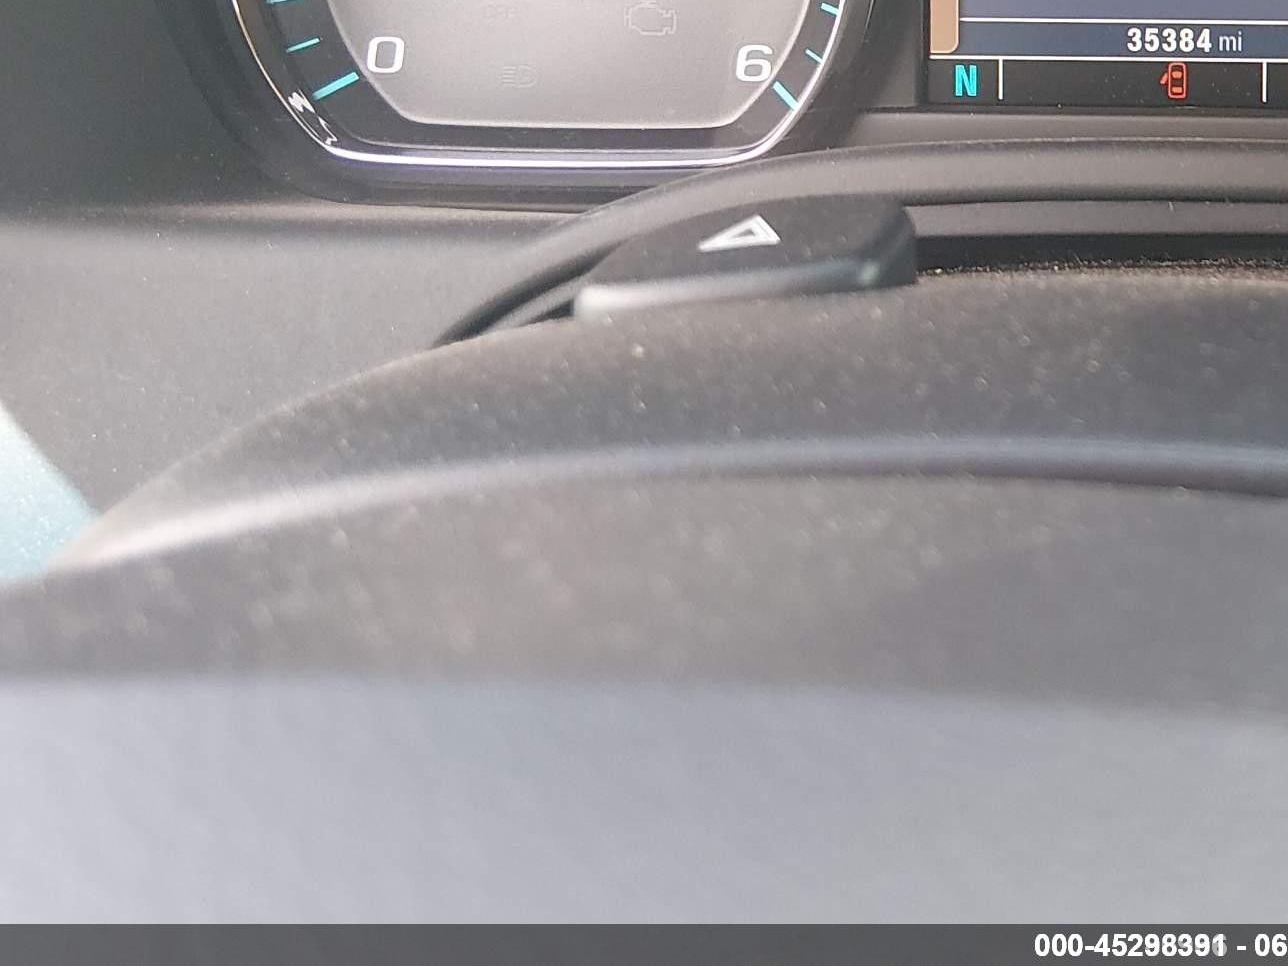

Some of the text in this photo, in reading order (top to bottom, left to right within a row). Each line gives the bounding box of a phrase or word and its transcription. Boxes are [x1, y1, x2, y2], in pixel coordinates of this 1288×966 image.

[366, 36, 405, 74] 0
[1127, 27, 1244, 53] 35384 mi
[735, 44, 773, 83] 6
[955, 64, 977, 97] N
